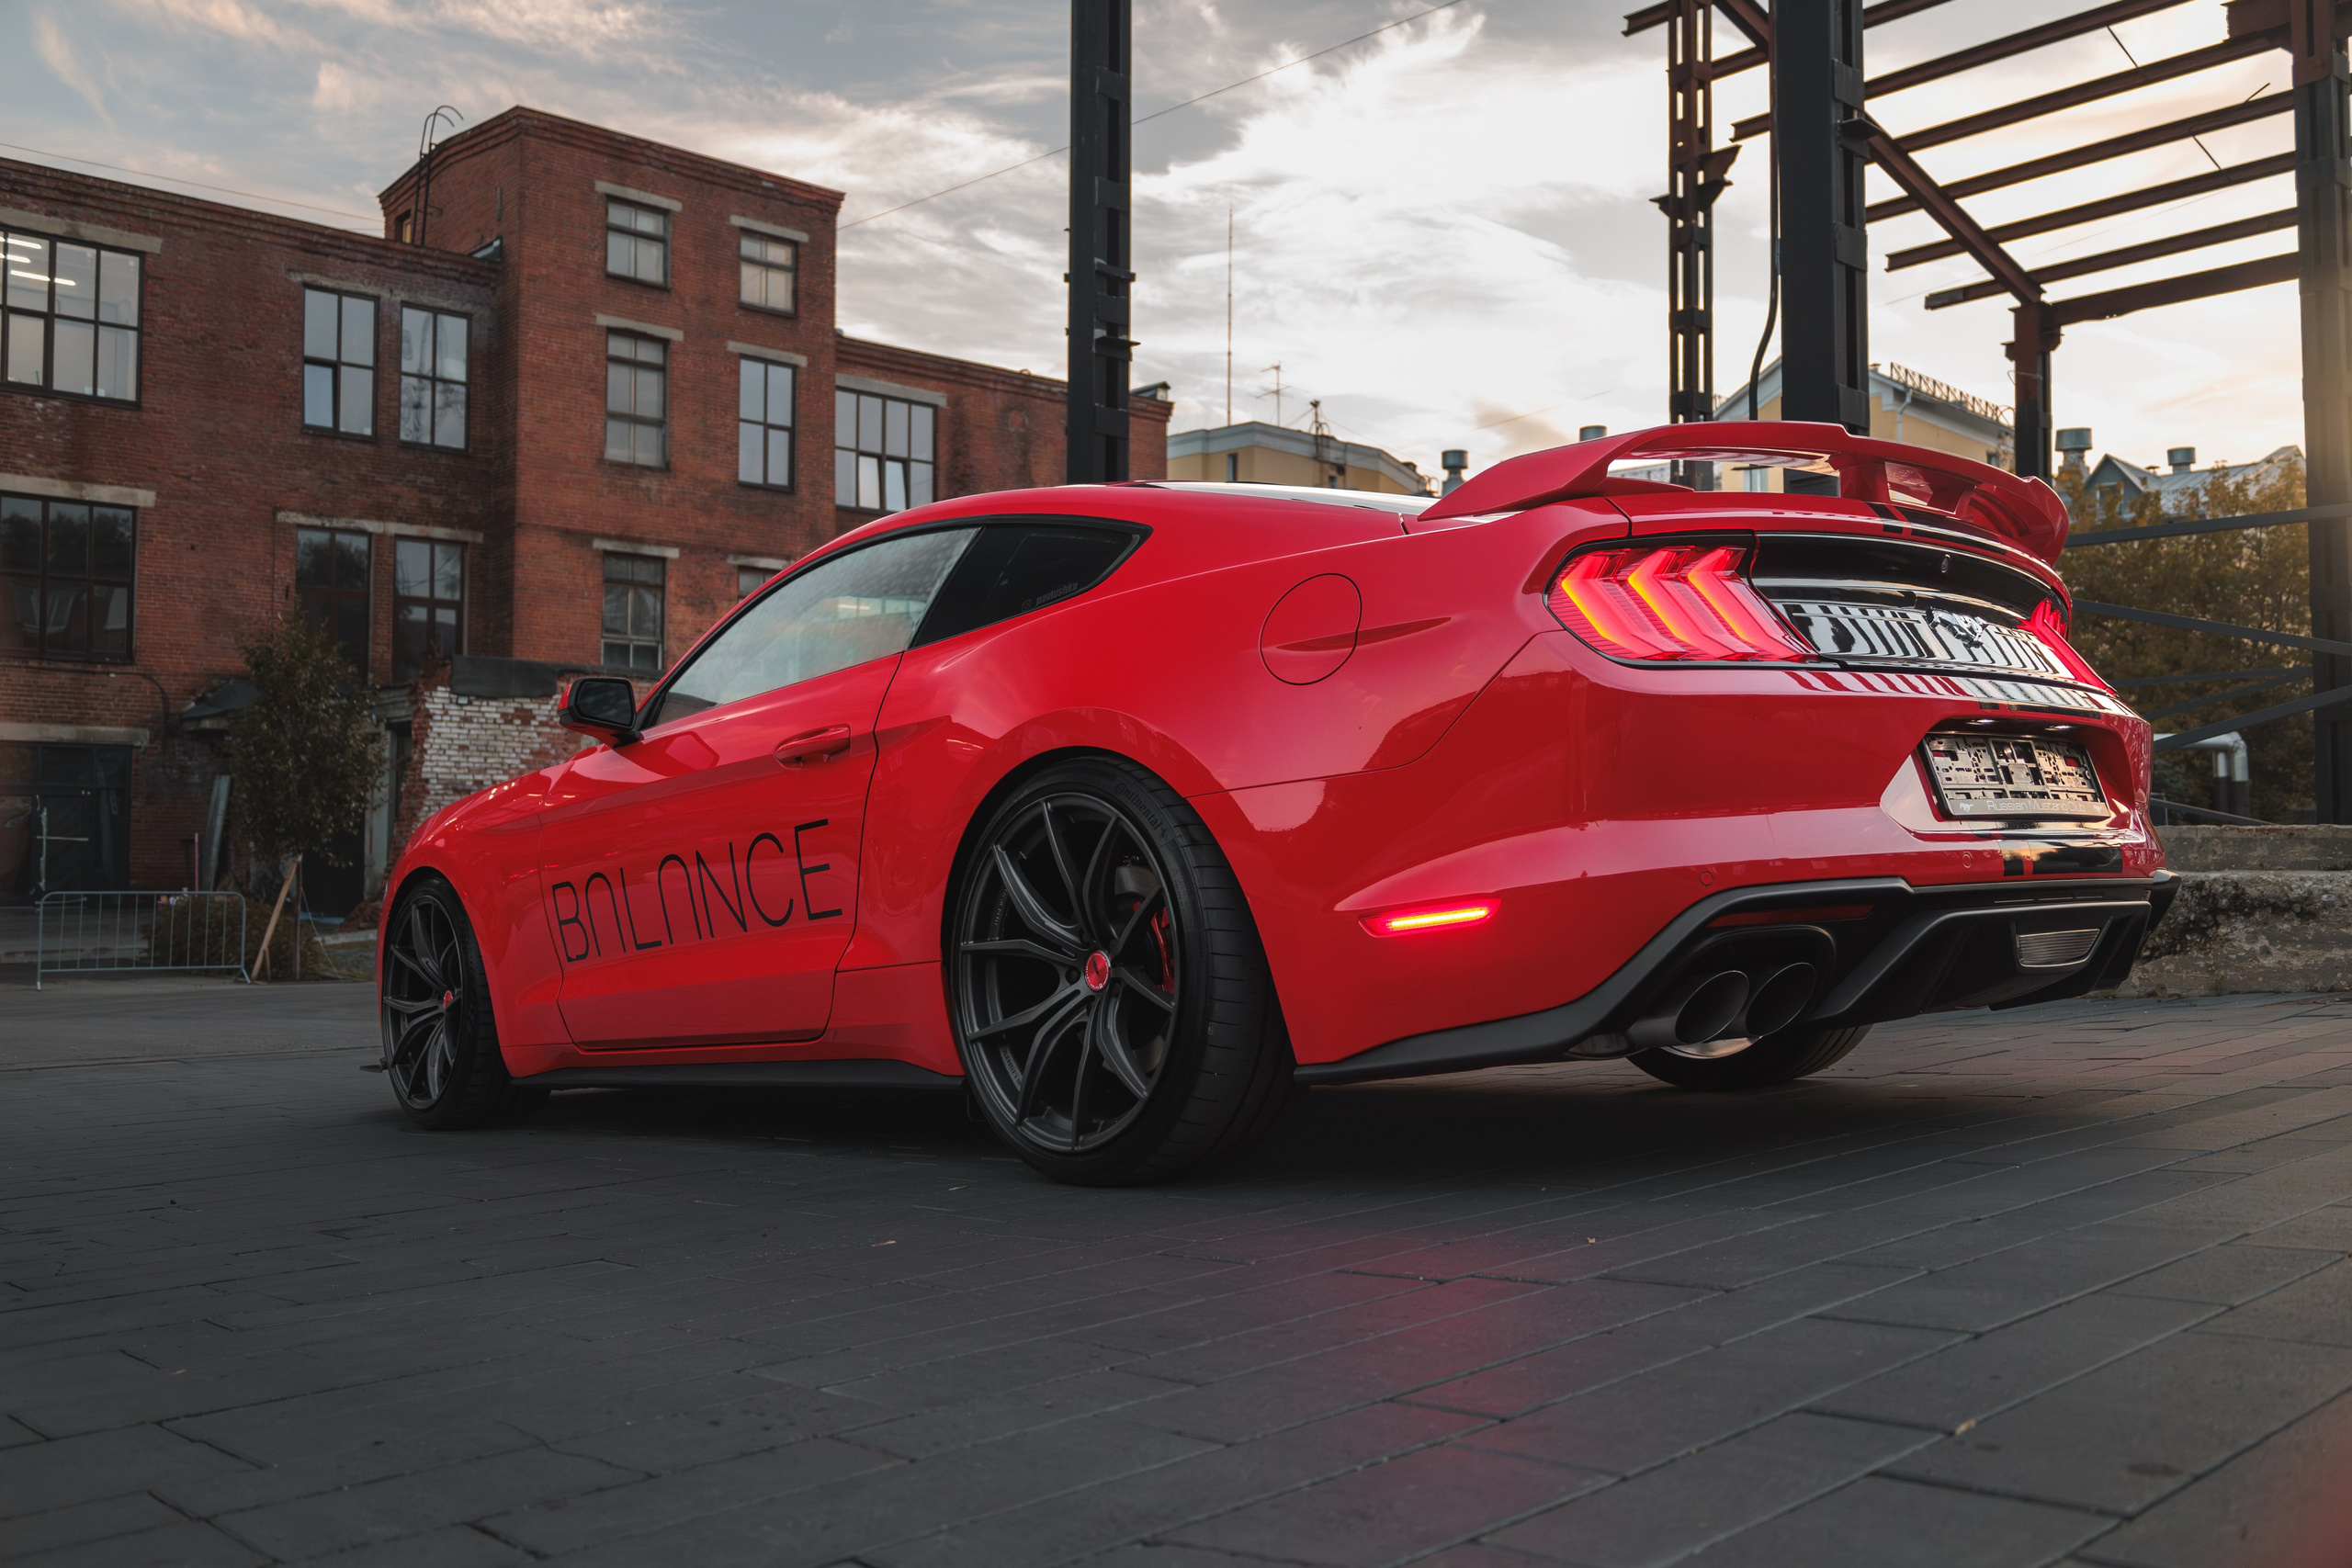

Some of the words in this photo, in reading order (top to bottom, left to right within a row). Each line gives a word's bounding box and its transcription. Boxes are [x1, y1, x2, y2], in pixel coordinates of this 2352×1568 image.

[1114, 783, 1163, 829] Continental
[1986, 800, 2027, 812] Russian
[2029, 801, 2068, 814] Mustang
[2068, 802, 2086, 813] Club
